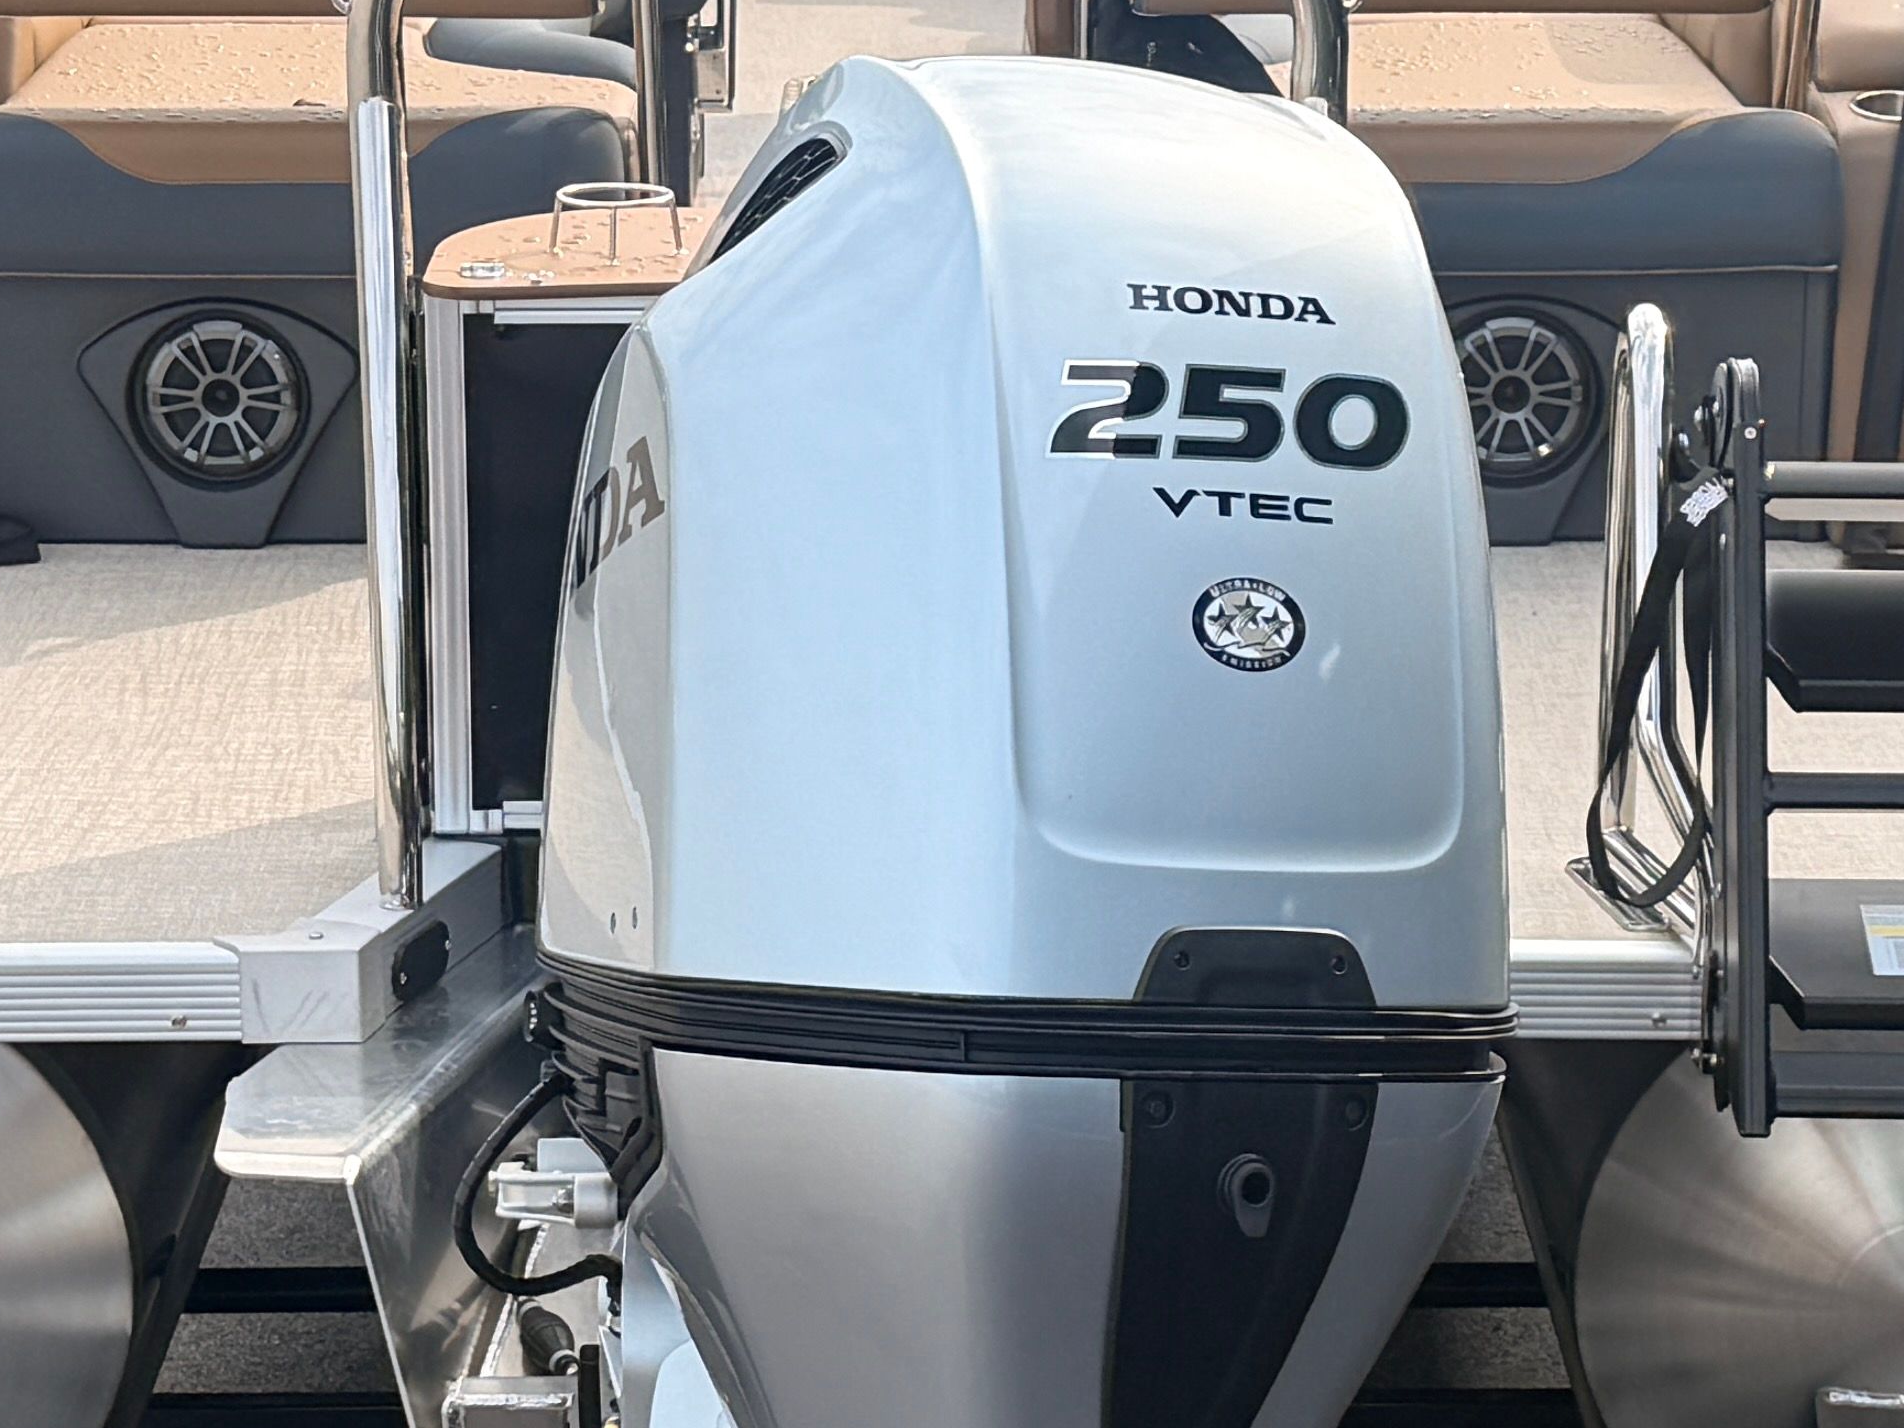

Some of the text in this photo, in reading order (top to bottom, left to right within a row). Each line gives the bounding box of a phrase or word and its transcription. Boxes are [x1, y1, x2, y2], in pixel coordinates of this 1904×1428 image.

[1127, 283, 1337, 325] HONDA
[1045, 358, 1411, 472] 250
[575, 435, 666, 589] NDA
[1152, 487, 1334, 524] VTEC
